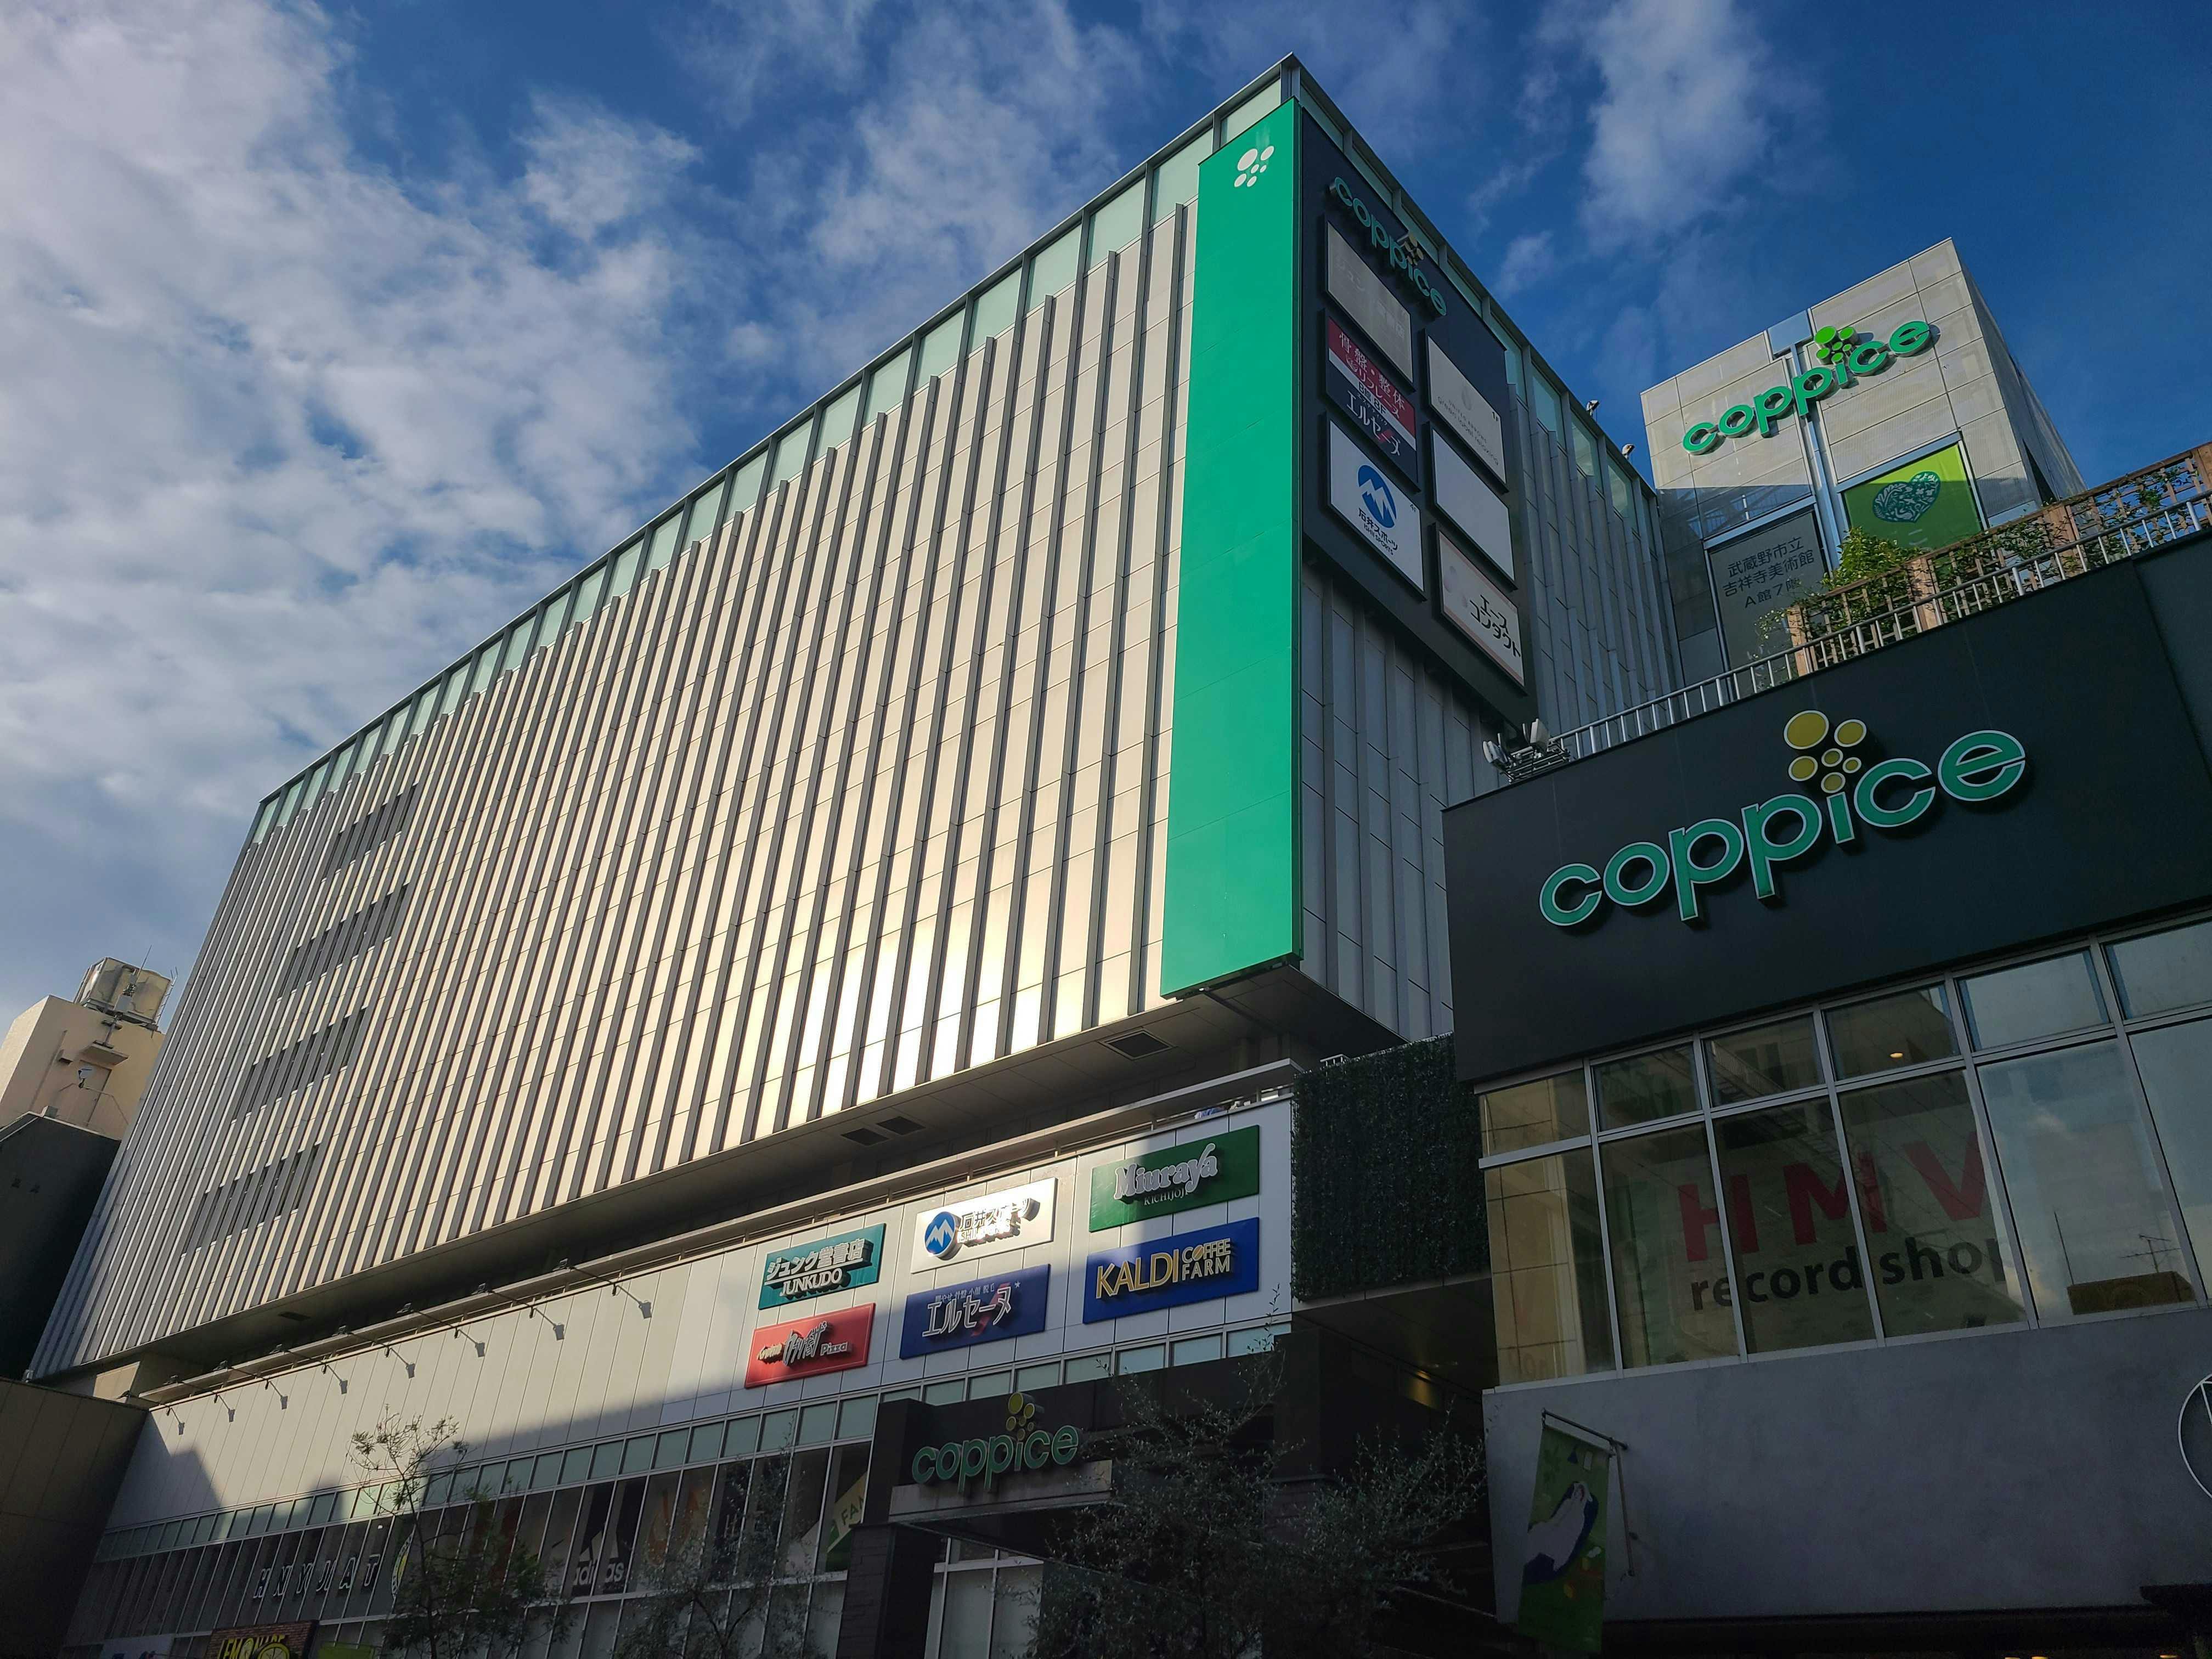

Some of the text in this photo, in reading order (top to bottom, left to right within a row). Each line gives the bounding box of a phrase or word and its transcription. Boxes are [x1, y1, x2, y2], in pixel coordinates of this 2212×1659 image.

[1334, 177, 1447, 316] coppice
[1339, 331, 1404, 410] 骨盤・整体
[1682, 320, 1930, 453] coppice
[1373, 399, 1387, 415] 8F
[1358, 507, 1398, 550] 石井スポーツ
[1375, 534, 1394, 555] SPORTS
[1723, 549, 1815, 597] 吉祥寺美術館
[1727, 537, 1804, 578] 武蔵野市立
[1470, 599, 1521, 658] コンタクト
[1480, 594, 1509, 634] エース
[1538, 730, 2026, 927] coppice
[1114, 1143, 1218, 1200] Miuraya
[1678, 1130, 1989, 1263] HMV
[767, 1238, 865, 1280] ジュンク堂書店
[780, 1268, 842, 1297] JUNKUDO
[1096, 1238, 1231, 1299] KALDI COFFEE
[1182, 1255, 1231, 1281] FARM
[1690, 1245, 1863, 1311] record
[922, 1286, 1012, 1337] エルセーヌ
[820, 1342, 848, 1357] Pizza
[912, 1425, 1079, 1493] coppice
[573, 1559, 624, 1587] dias
